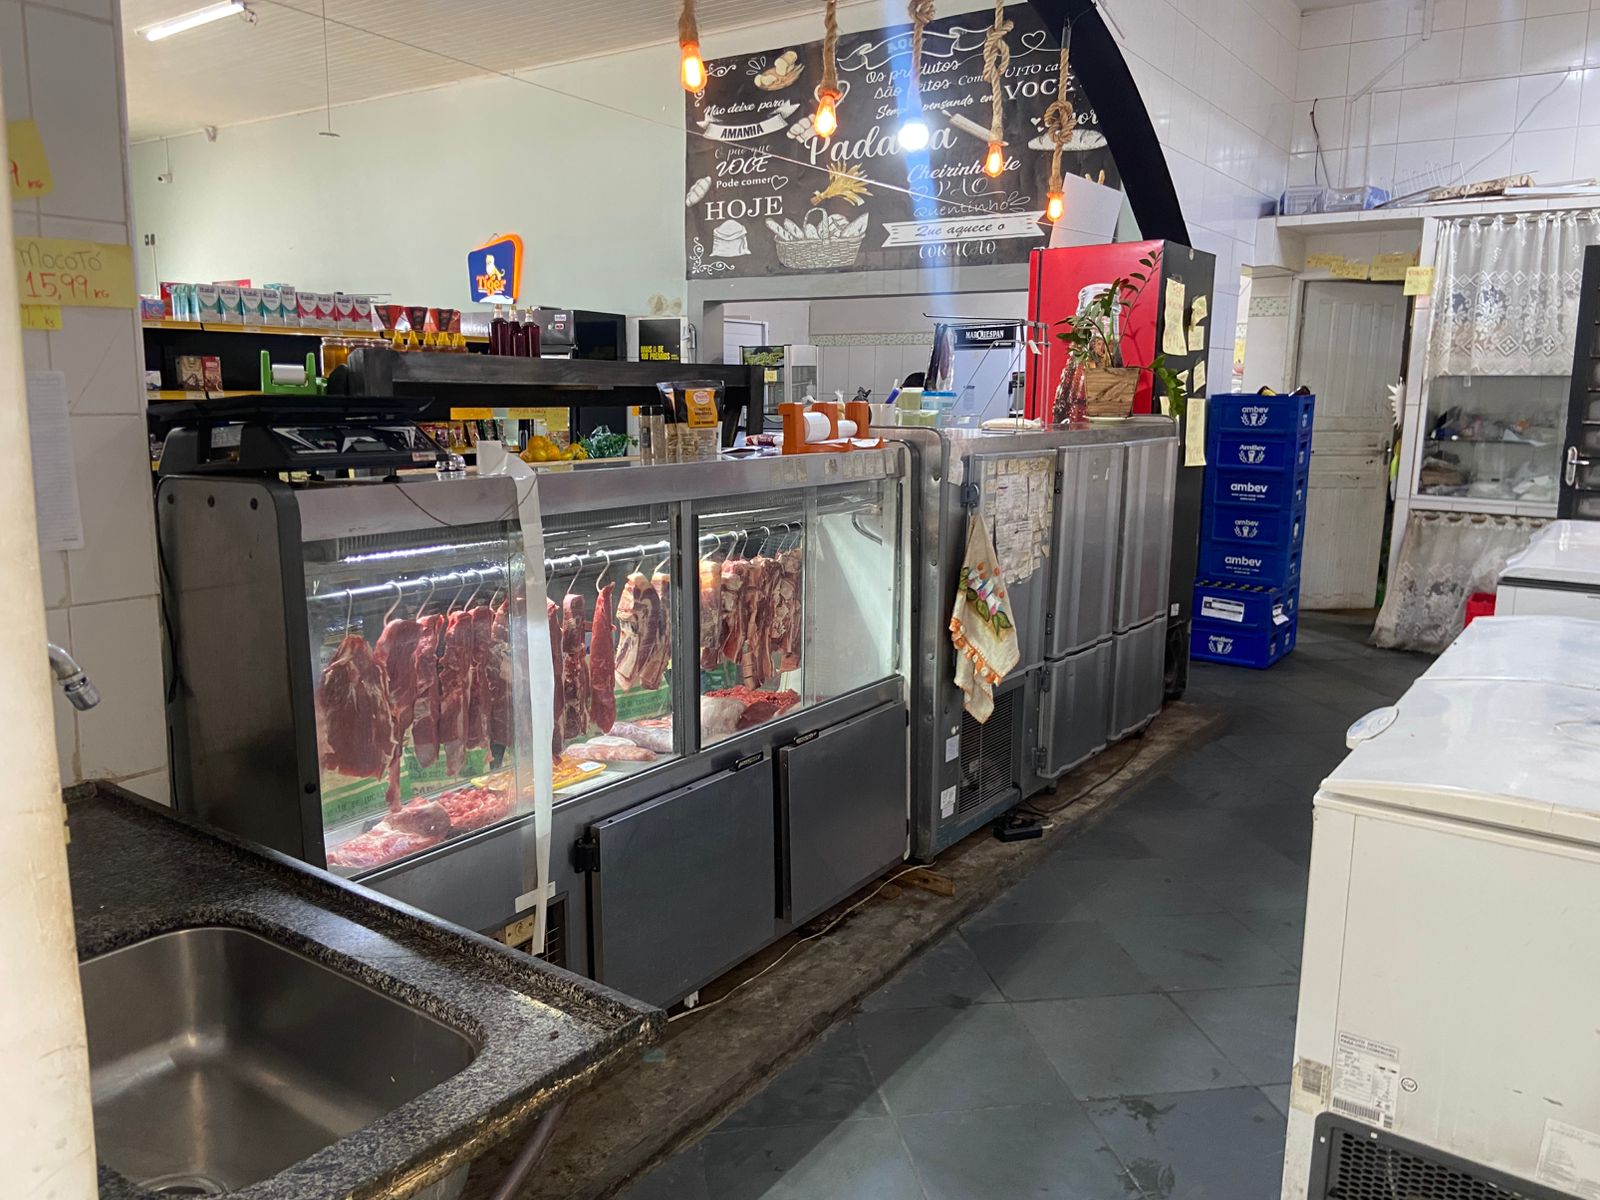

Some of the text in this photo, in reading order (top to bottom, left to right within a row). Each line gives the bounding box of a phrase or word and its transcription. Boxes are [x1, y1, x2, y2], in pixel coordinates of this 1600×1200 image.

[716, 177, 772, 189] Pode comer
[704, 195, 783, 220] HOJE
[946, 224, 992, 237] aquece
[25, 271, 89, 300] 15,99
[476, 275, 506, 296] Tiger
[1230, 482, 1268, 493] ambev
[1234, 519, 1259, 527] ambev
[1224, 556, 1262, 567] ambev
